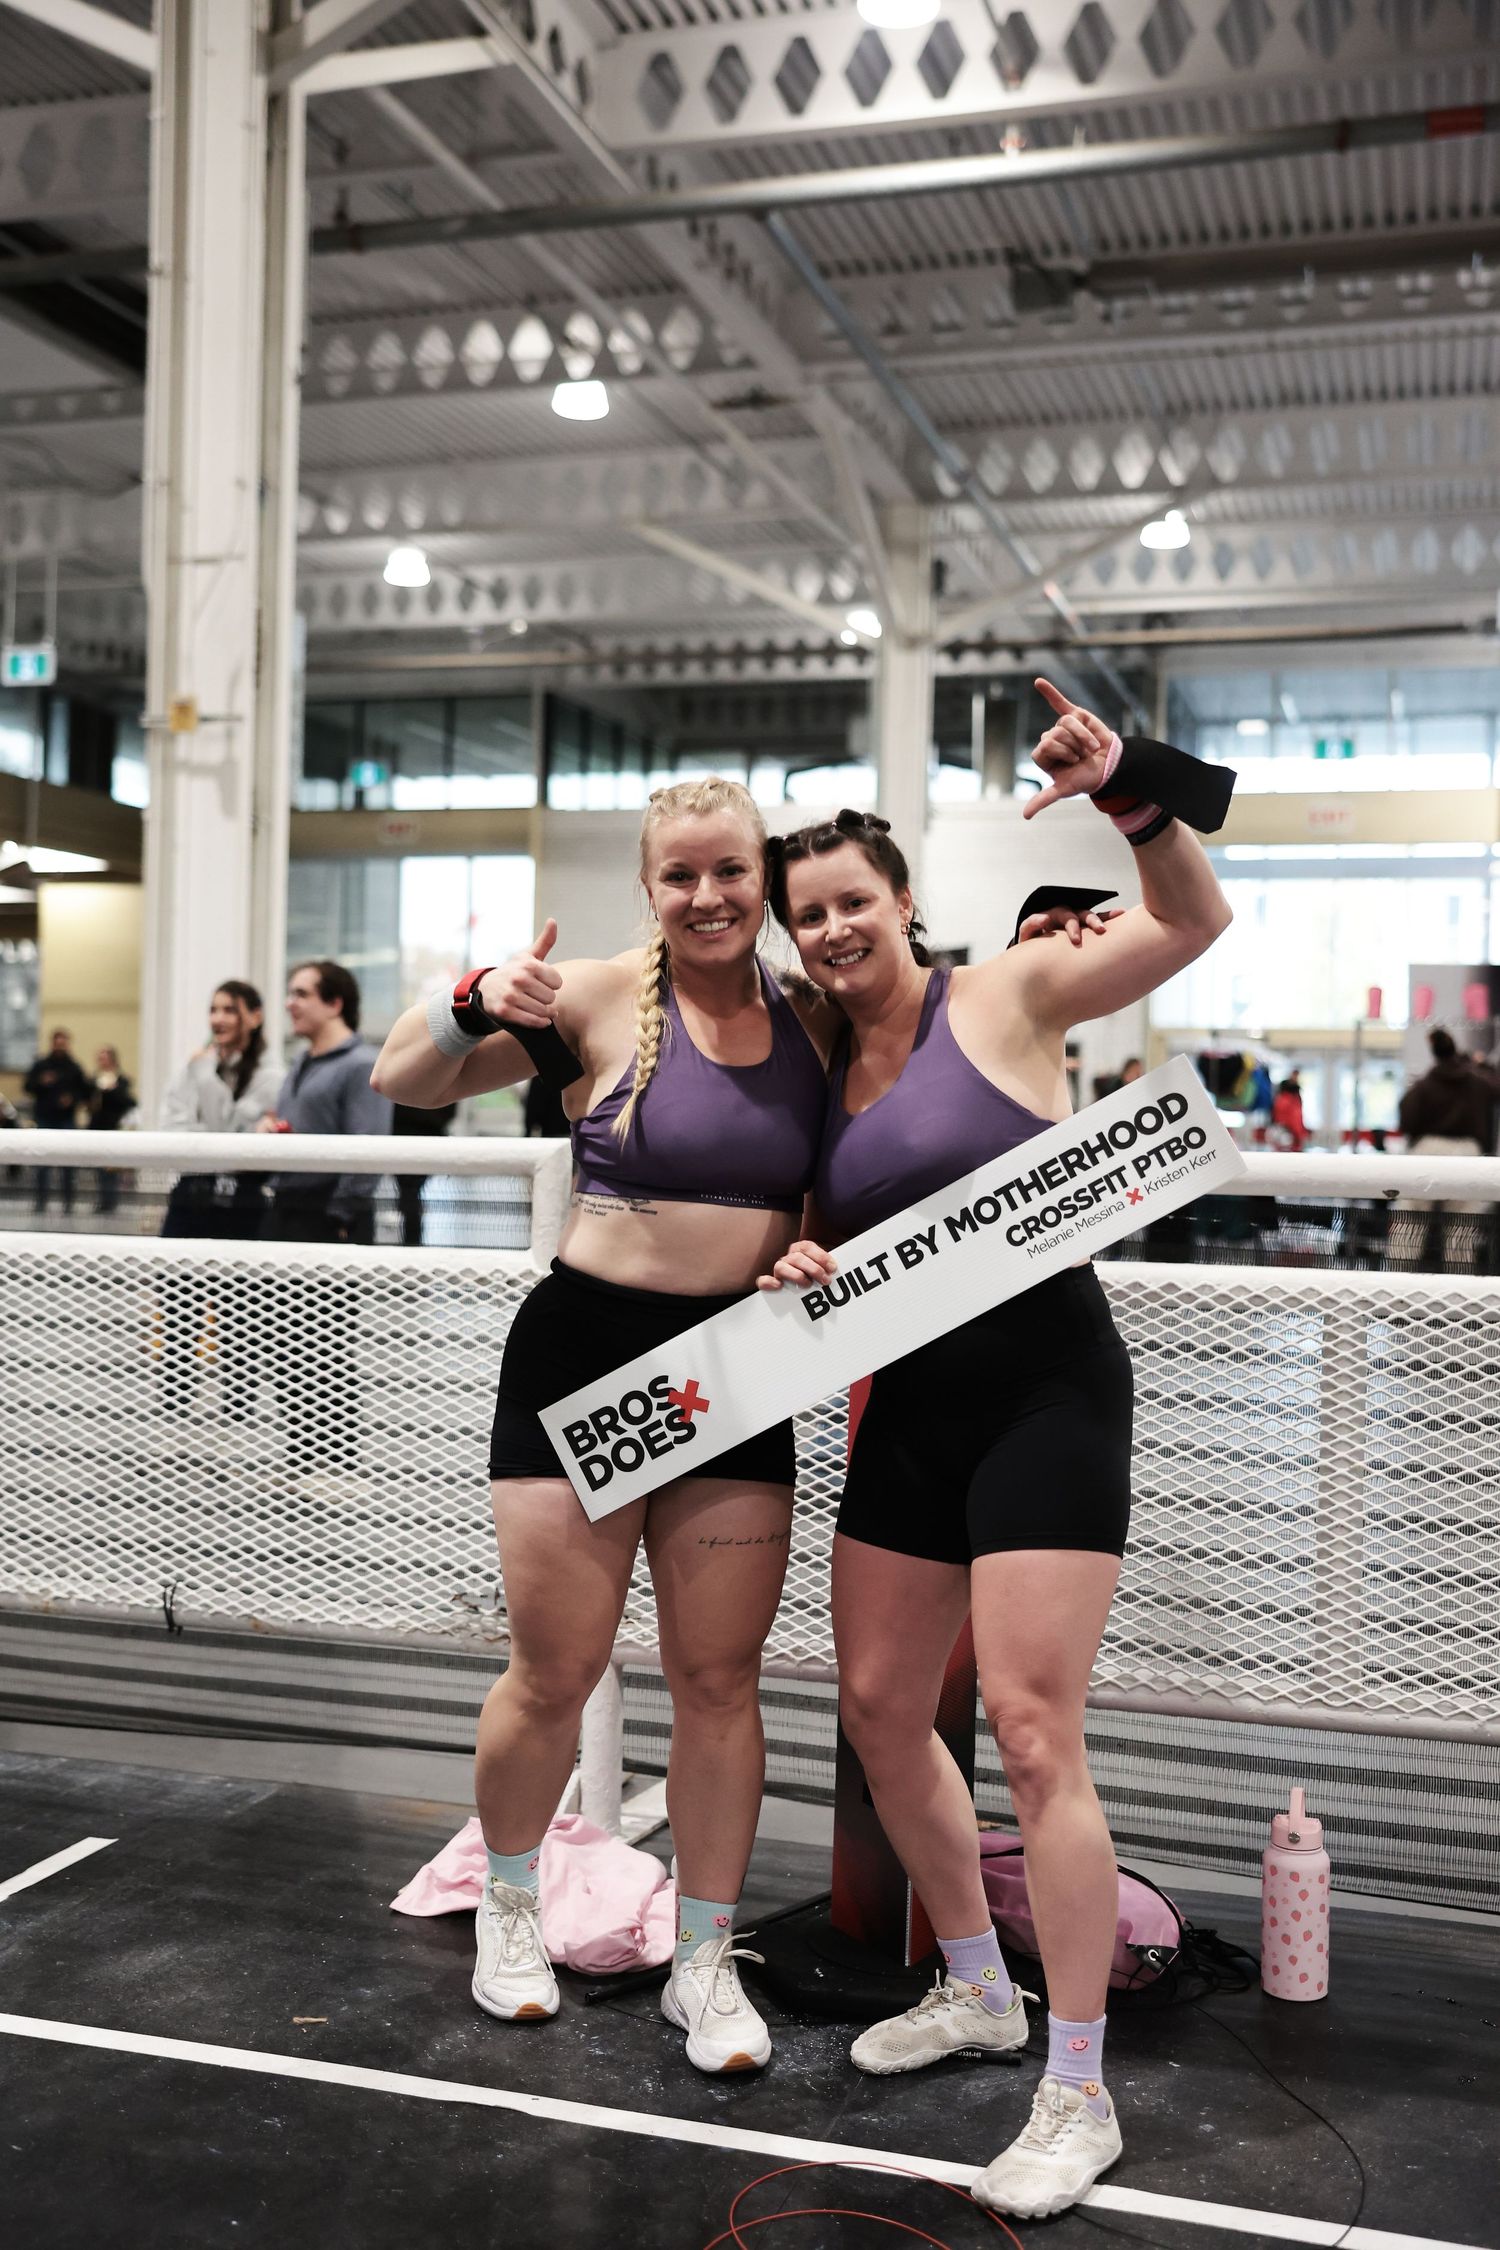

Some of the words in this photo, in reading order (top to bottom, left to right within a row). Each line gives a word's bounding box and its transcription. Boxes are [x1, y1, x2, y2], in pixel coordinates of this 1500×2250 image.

[801, 1252, 891, 1321] BUILT
[894, 1224, 939, 1270] BY
[943, 1092, 1188, 1243] MOTHERHOOD
[1006, 1166, 1129, 1247] CROSSFIT
[1132, 1126, 1206, 1179] PTBO
[1027, 1228, 1075, 1259] Melanie
[1075, 1203, 1125, 1233] Messina
[1143, 1167, 1189, 1195] Kristen
[1189, 1148, 1218, 1170] Kerr
[562, 1375, 678, 1459] BROS
[578, 1409, 696, 1492] DOES
